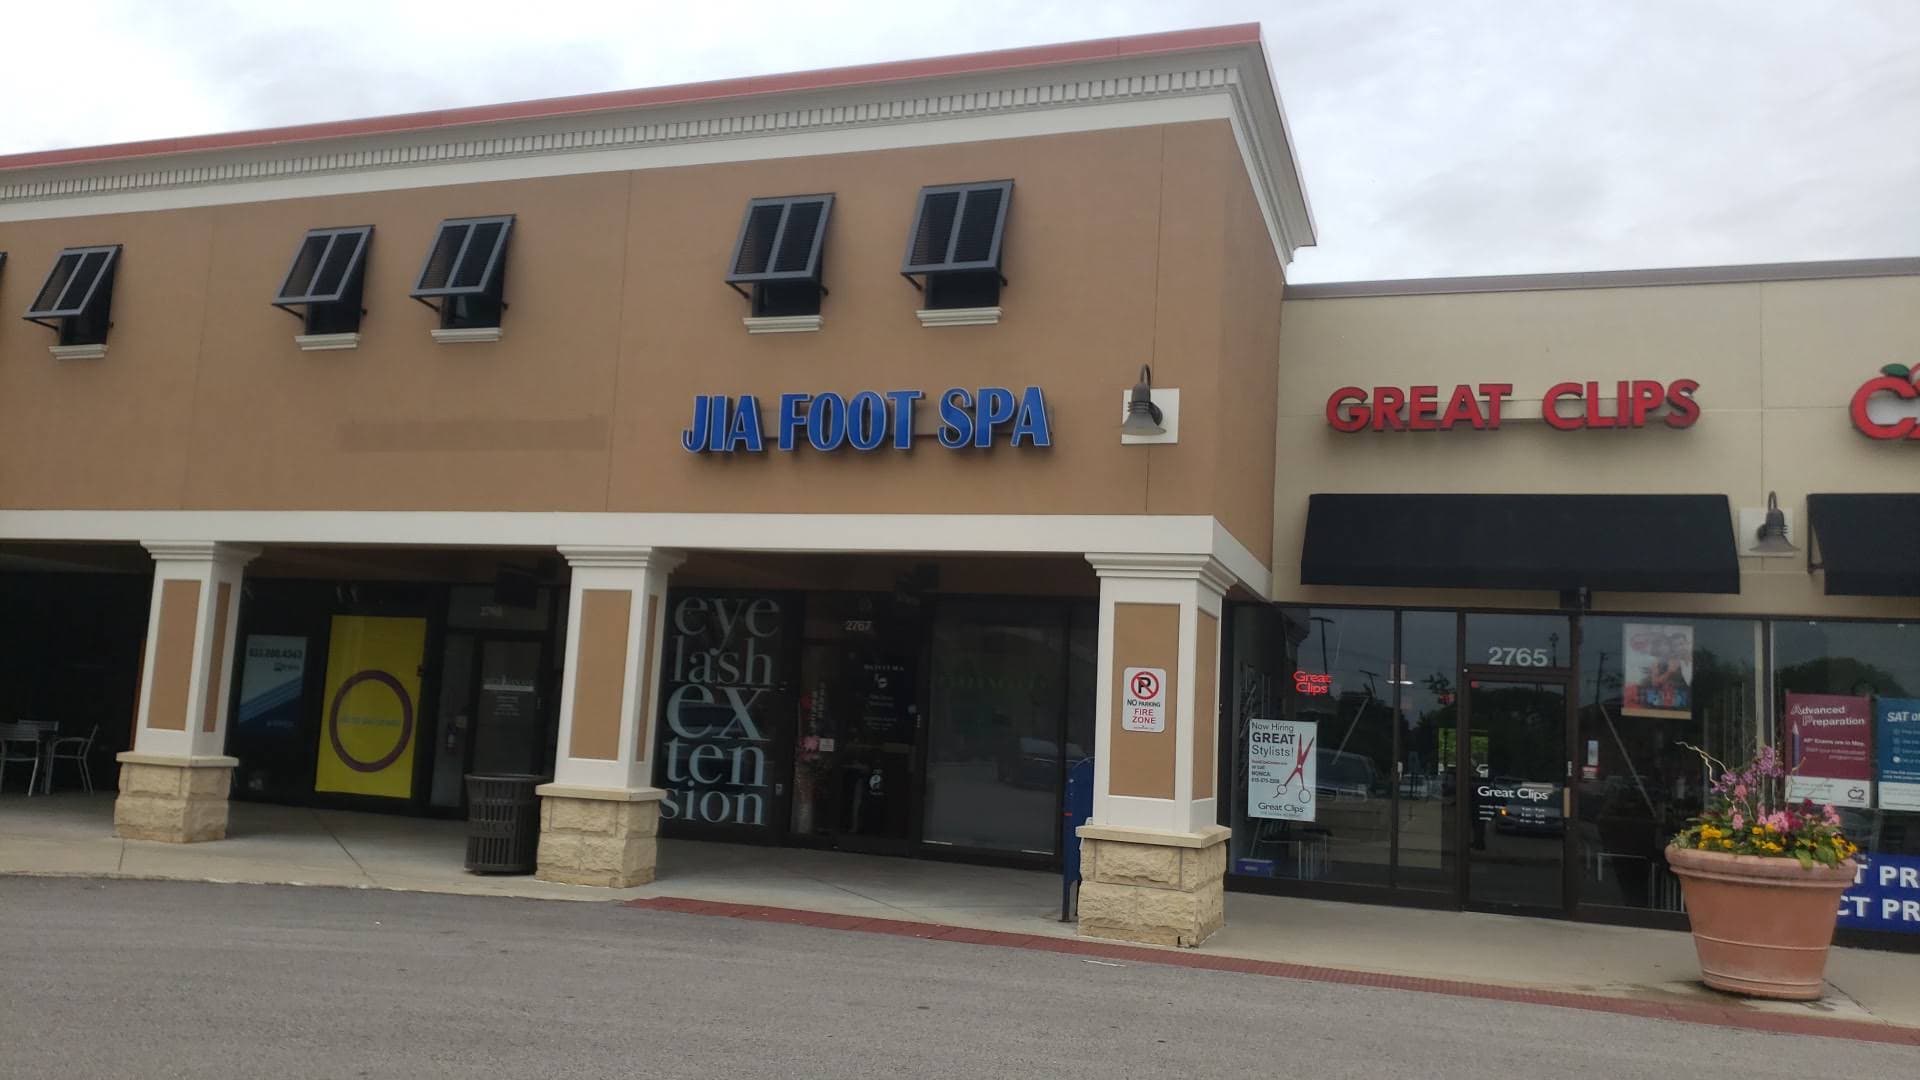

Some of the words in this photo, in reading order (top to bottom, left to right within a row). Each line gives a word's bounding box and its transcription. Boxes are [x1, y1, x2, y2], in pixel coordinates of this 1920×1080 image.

[1326, 383, 1513, 432] GREAT
[1542, 378, 1700, 431] CLIPS
[681, 394, 763, 454] JIA
[778, 390, 923, 452] FOOT
[937, 386, 1051, 449] SPA
[674, 596, 780, 655] eye
[845, 620, 873, 631] 2767
[670, 634, 774, 687] lash
[1488, 646, 1548, 668] 2765
[1293, 671, 1332, 682] Great
[1296, 682, 1328, 696] Clips
[666, 683, 772, 742] ex
[1134, 708, 1154, 716] FIRE
[1790, 703, 1846, 715] Advanced
[1132, 716, 1156, 724] ZONE
[1802, 715, 1865, 728] Preparation
[1887, 711, 1910, 722] SAT
[1251, 722, 1269, 730] Now
[1271, 723, 1294, 733] Hiring
[1252, 732, 1295, 745] GREAT
[1251, 744, 1294, 759] Stylists!
[665, 736, 769, 787] ten
[1477, 786, 1515, 798] Great
[1517, 788, 1549, 802] Clips
[659, 780, 768, 826] sion
[1258, 802, 1283, 811] Great
[1284, 804, 1305, 813] Clips
